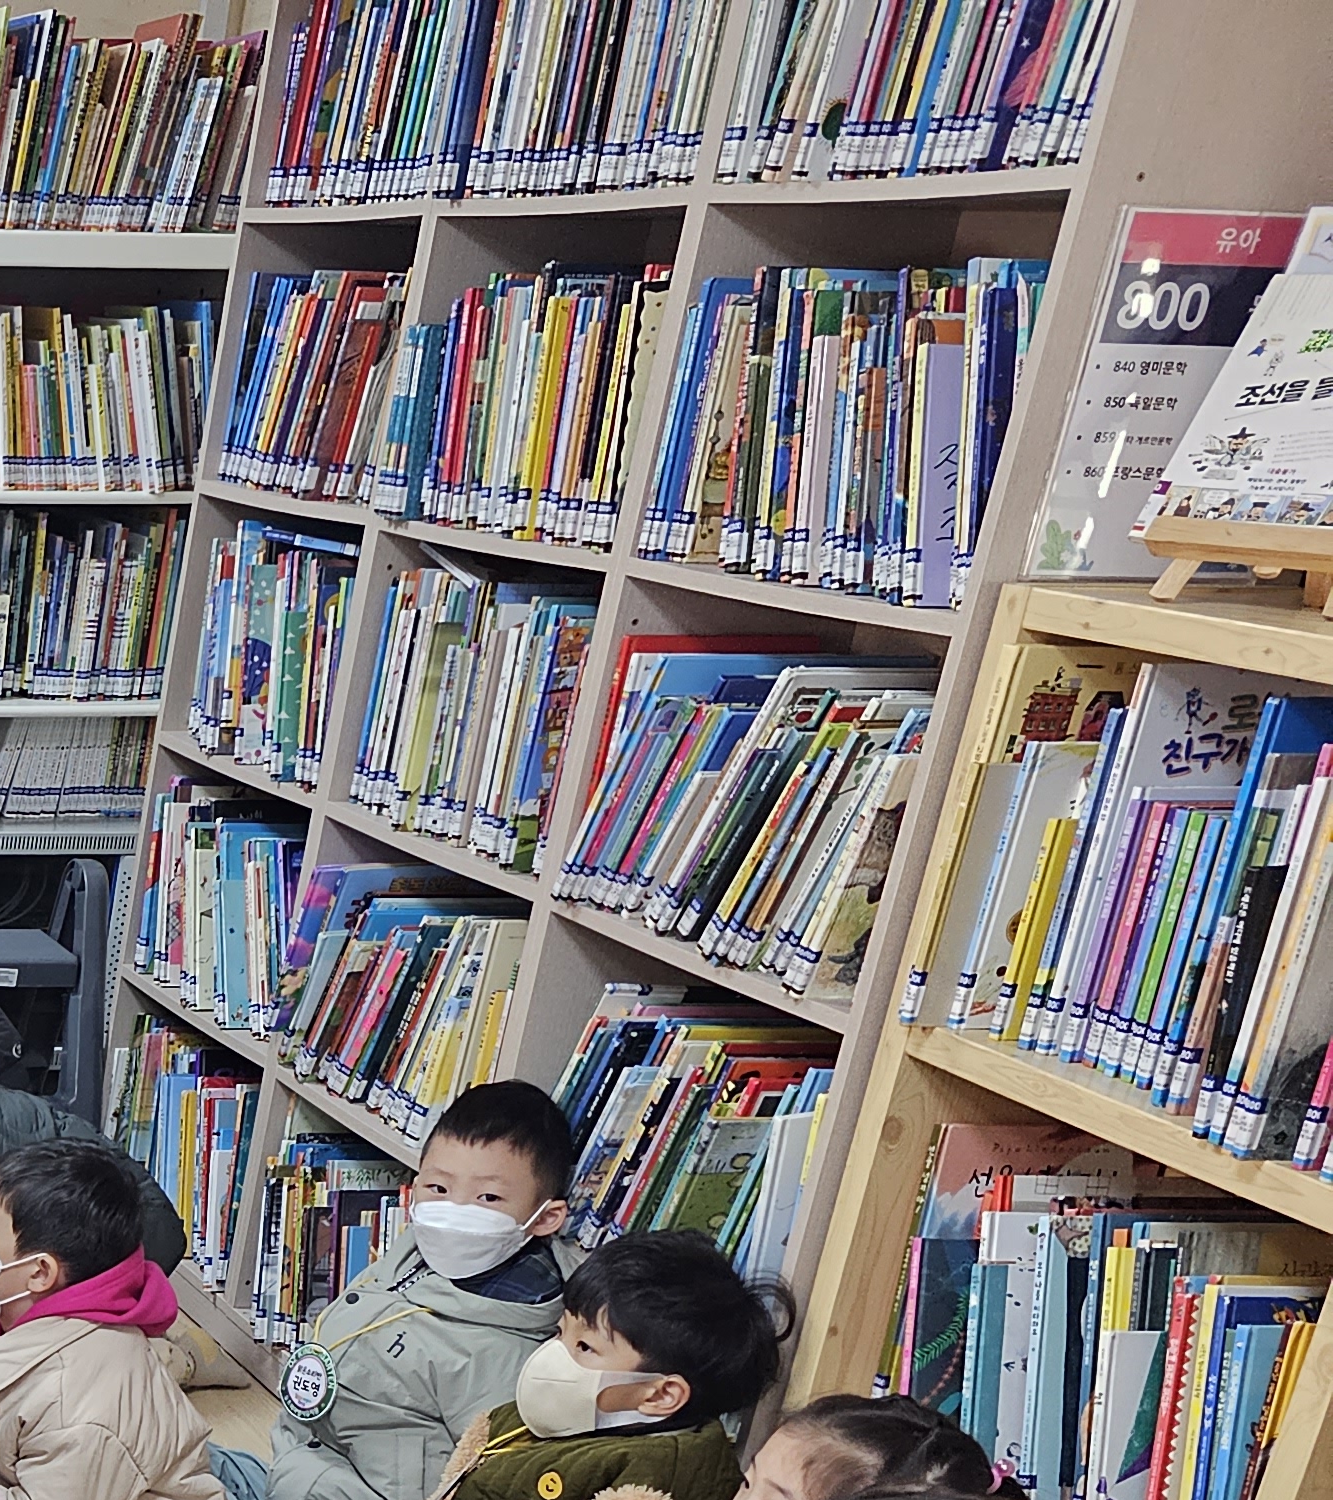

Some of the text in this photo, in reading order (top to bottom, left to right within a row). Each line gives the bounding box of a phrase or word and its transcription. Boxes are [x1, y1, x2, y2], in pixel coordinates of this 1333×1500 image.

[1216, 227, 1261, 254] 유아
[1116, 281, 1211, 331] 800
[1113, 361, 1188, 376] 840 영미문학
[1234, 379, 1311, 408] 조선을
[1103, 396, 1127, 409] 850
[1093, 431, 1117, 444] 859
[1082, 466, 1105, 478] 860
